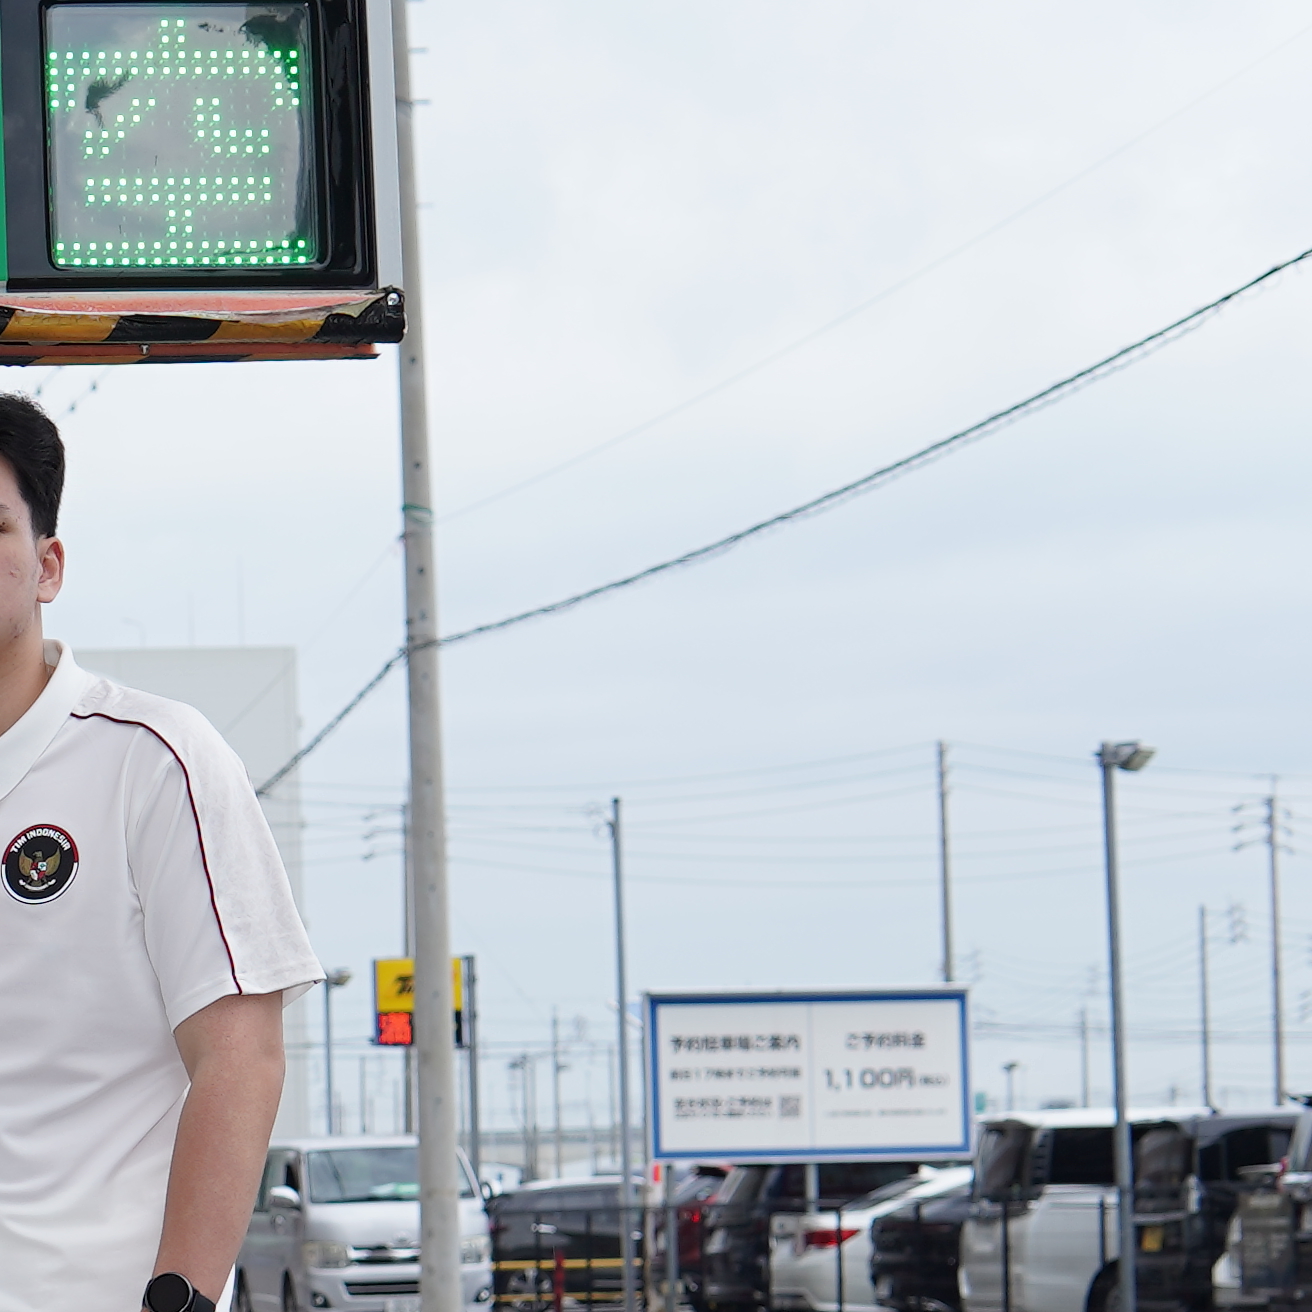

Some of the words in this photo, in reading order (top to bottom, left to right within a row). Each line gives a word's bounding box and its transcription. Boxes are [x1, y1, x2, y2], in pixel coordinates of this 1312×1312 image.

[49, 18, 308, 267] 空
[9, 835, 28, 853] TIM
[26, 828, 71, 851] INDONESIA
